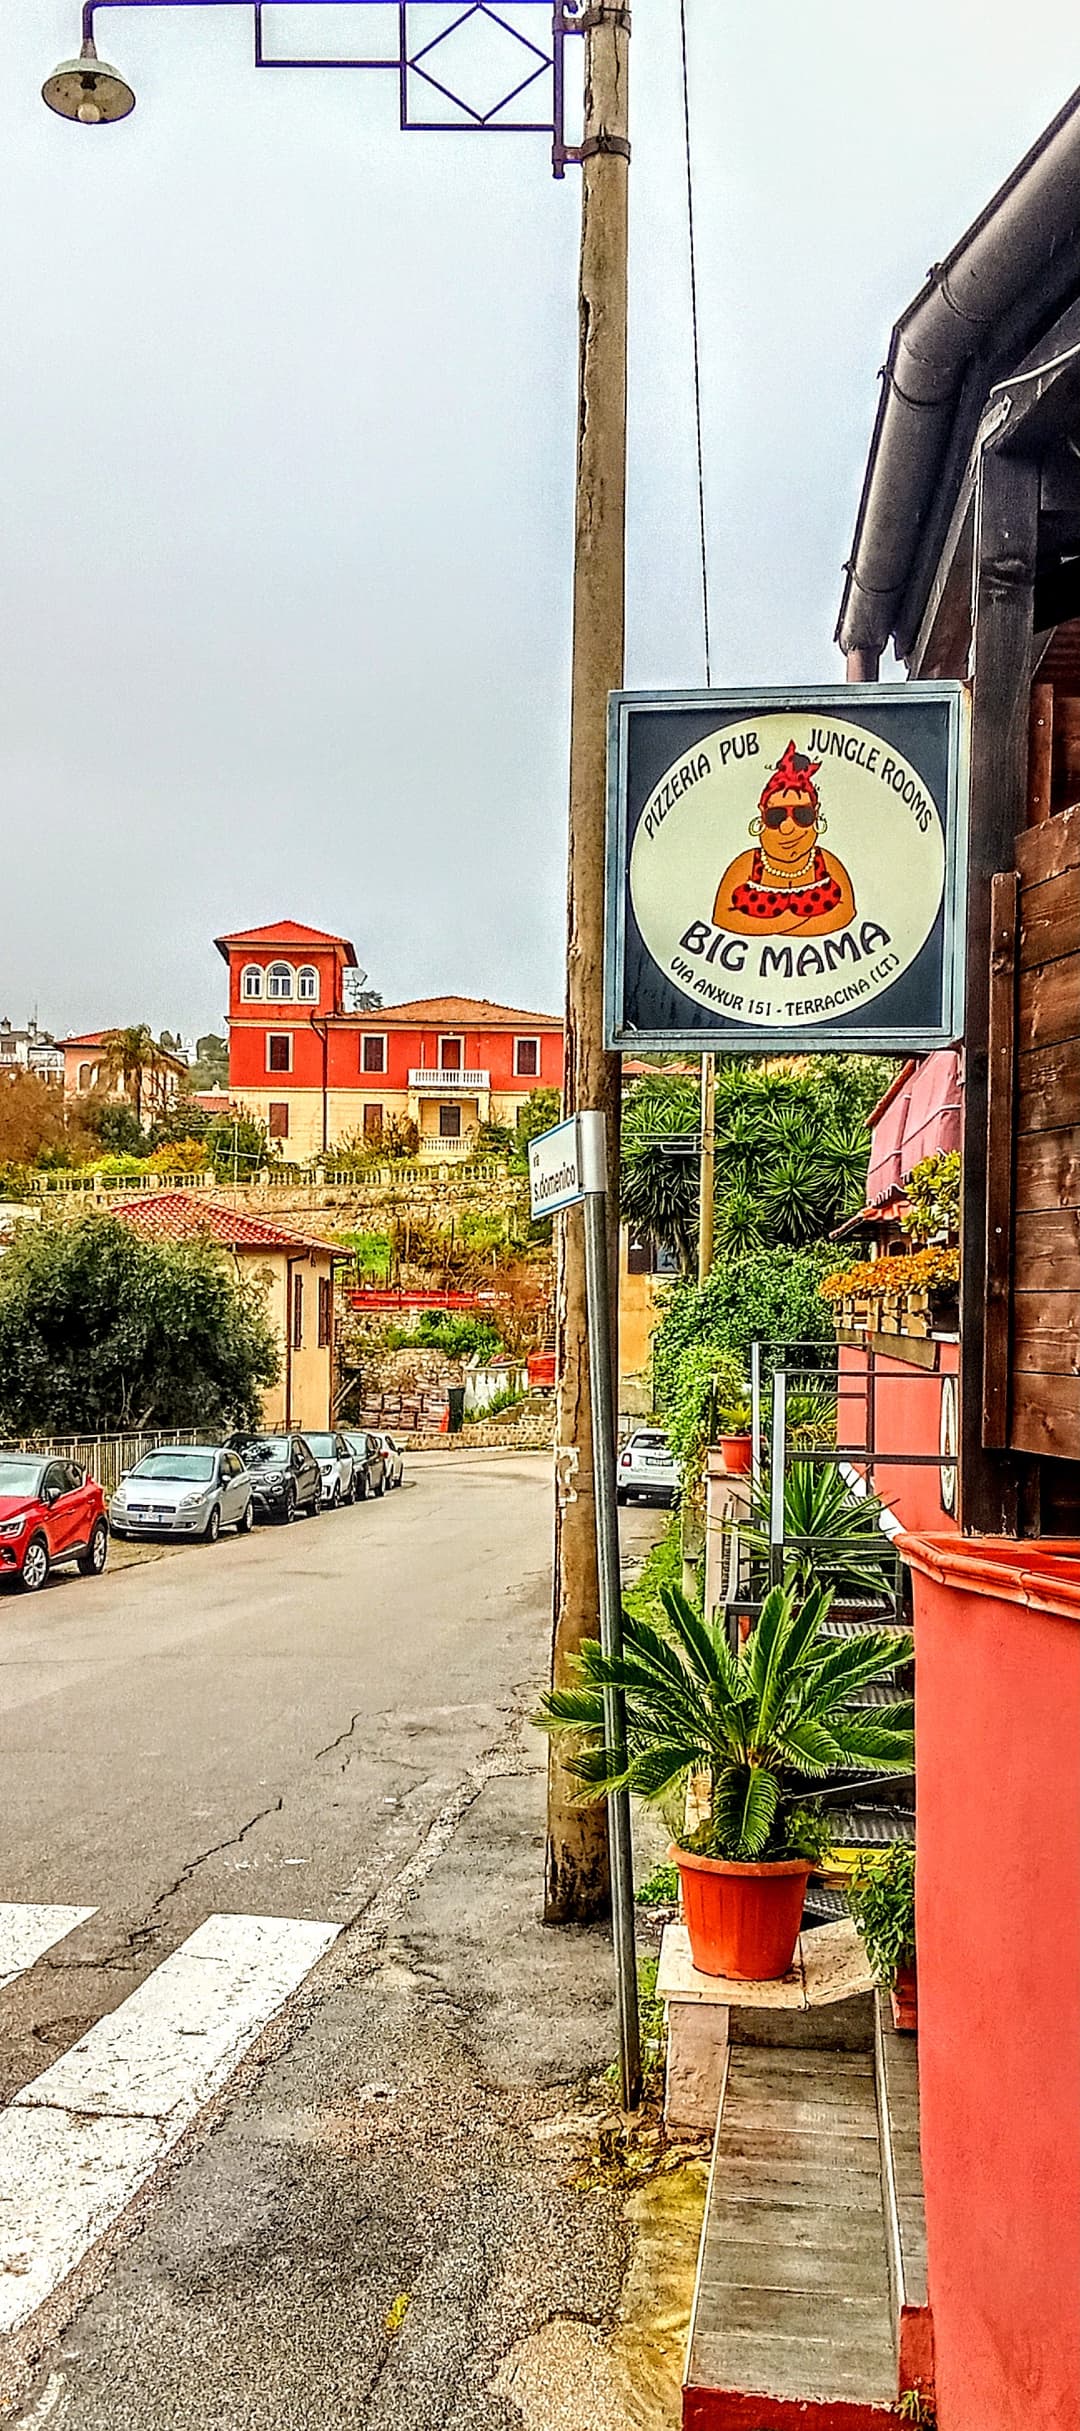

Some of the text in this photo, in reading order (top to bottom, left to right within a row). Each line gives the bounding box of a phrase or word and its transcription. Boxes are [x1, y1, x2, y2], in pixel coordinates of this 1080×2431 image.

[643, 732, 760, 840] PIZZERIA PUB
[807, 728, 933, 833] JUNGLE ROOMS
[671, 956, 695, 984] VIA
[693, 978, 743, 1011] ANXUR
[747, 1000, 772, 1017] 151
[784, 978, 871, 1017] TERRACINA
[870, 953, 901, 984] (LT)
[679, 920, 891, 978] BIG MAMA
